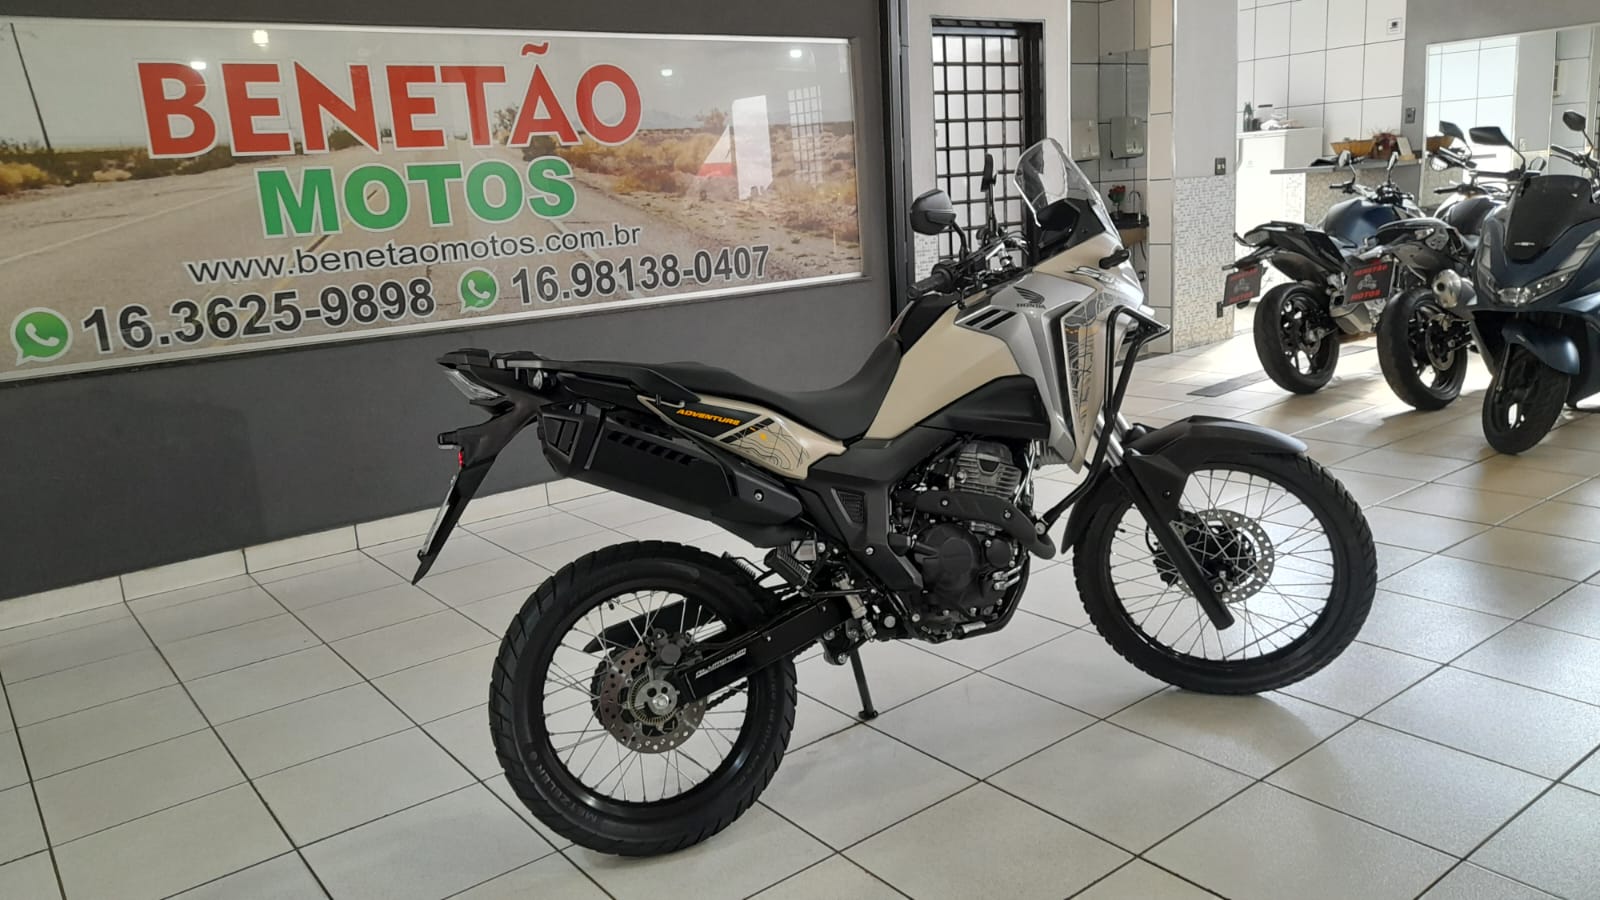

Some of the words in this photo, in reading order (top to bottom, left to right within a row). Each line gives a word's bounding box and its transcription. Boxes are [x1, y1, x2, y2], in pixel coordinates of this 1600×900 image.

[137, 42, 642, 155] BENETÃO
[257, 158, 575, 235] MOTOS
[187, 224, 641, 282] www.benetaomotos.com.br
[512, 245, 769, 304] 16.98138-0407
[84, 278, 435, 352] 16.3625-9898
[676, 409, 741, 426] ADVENTURE
